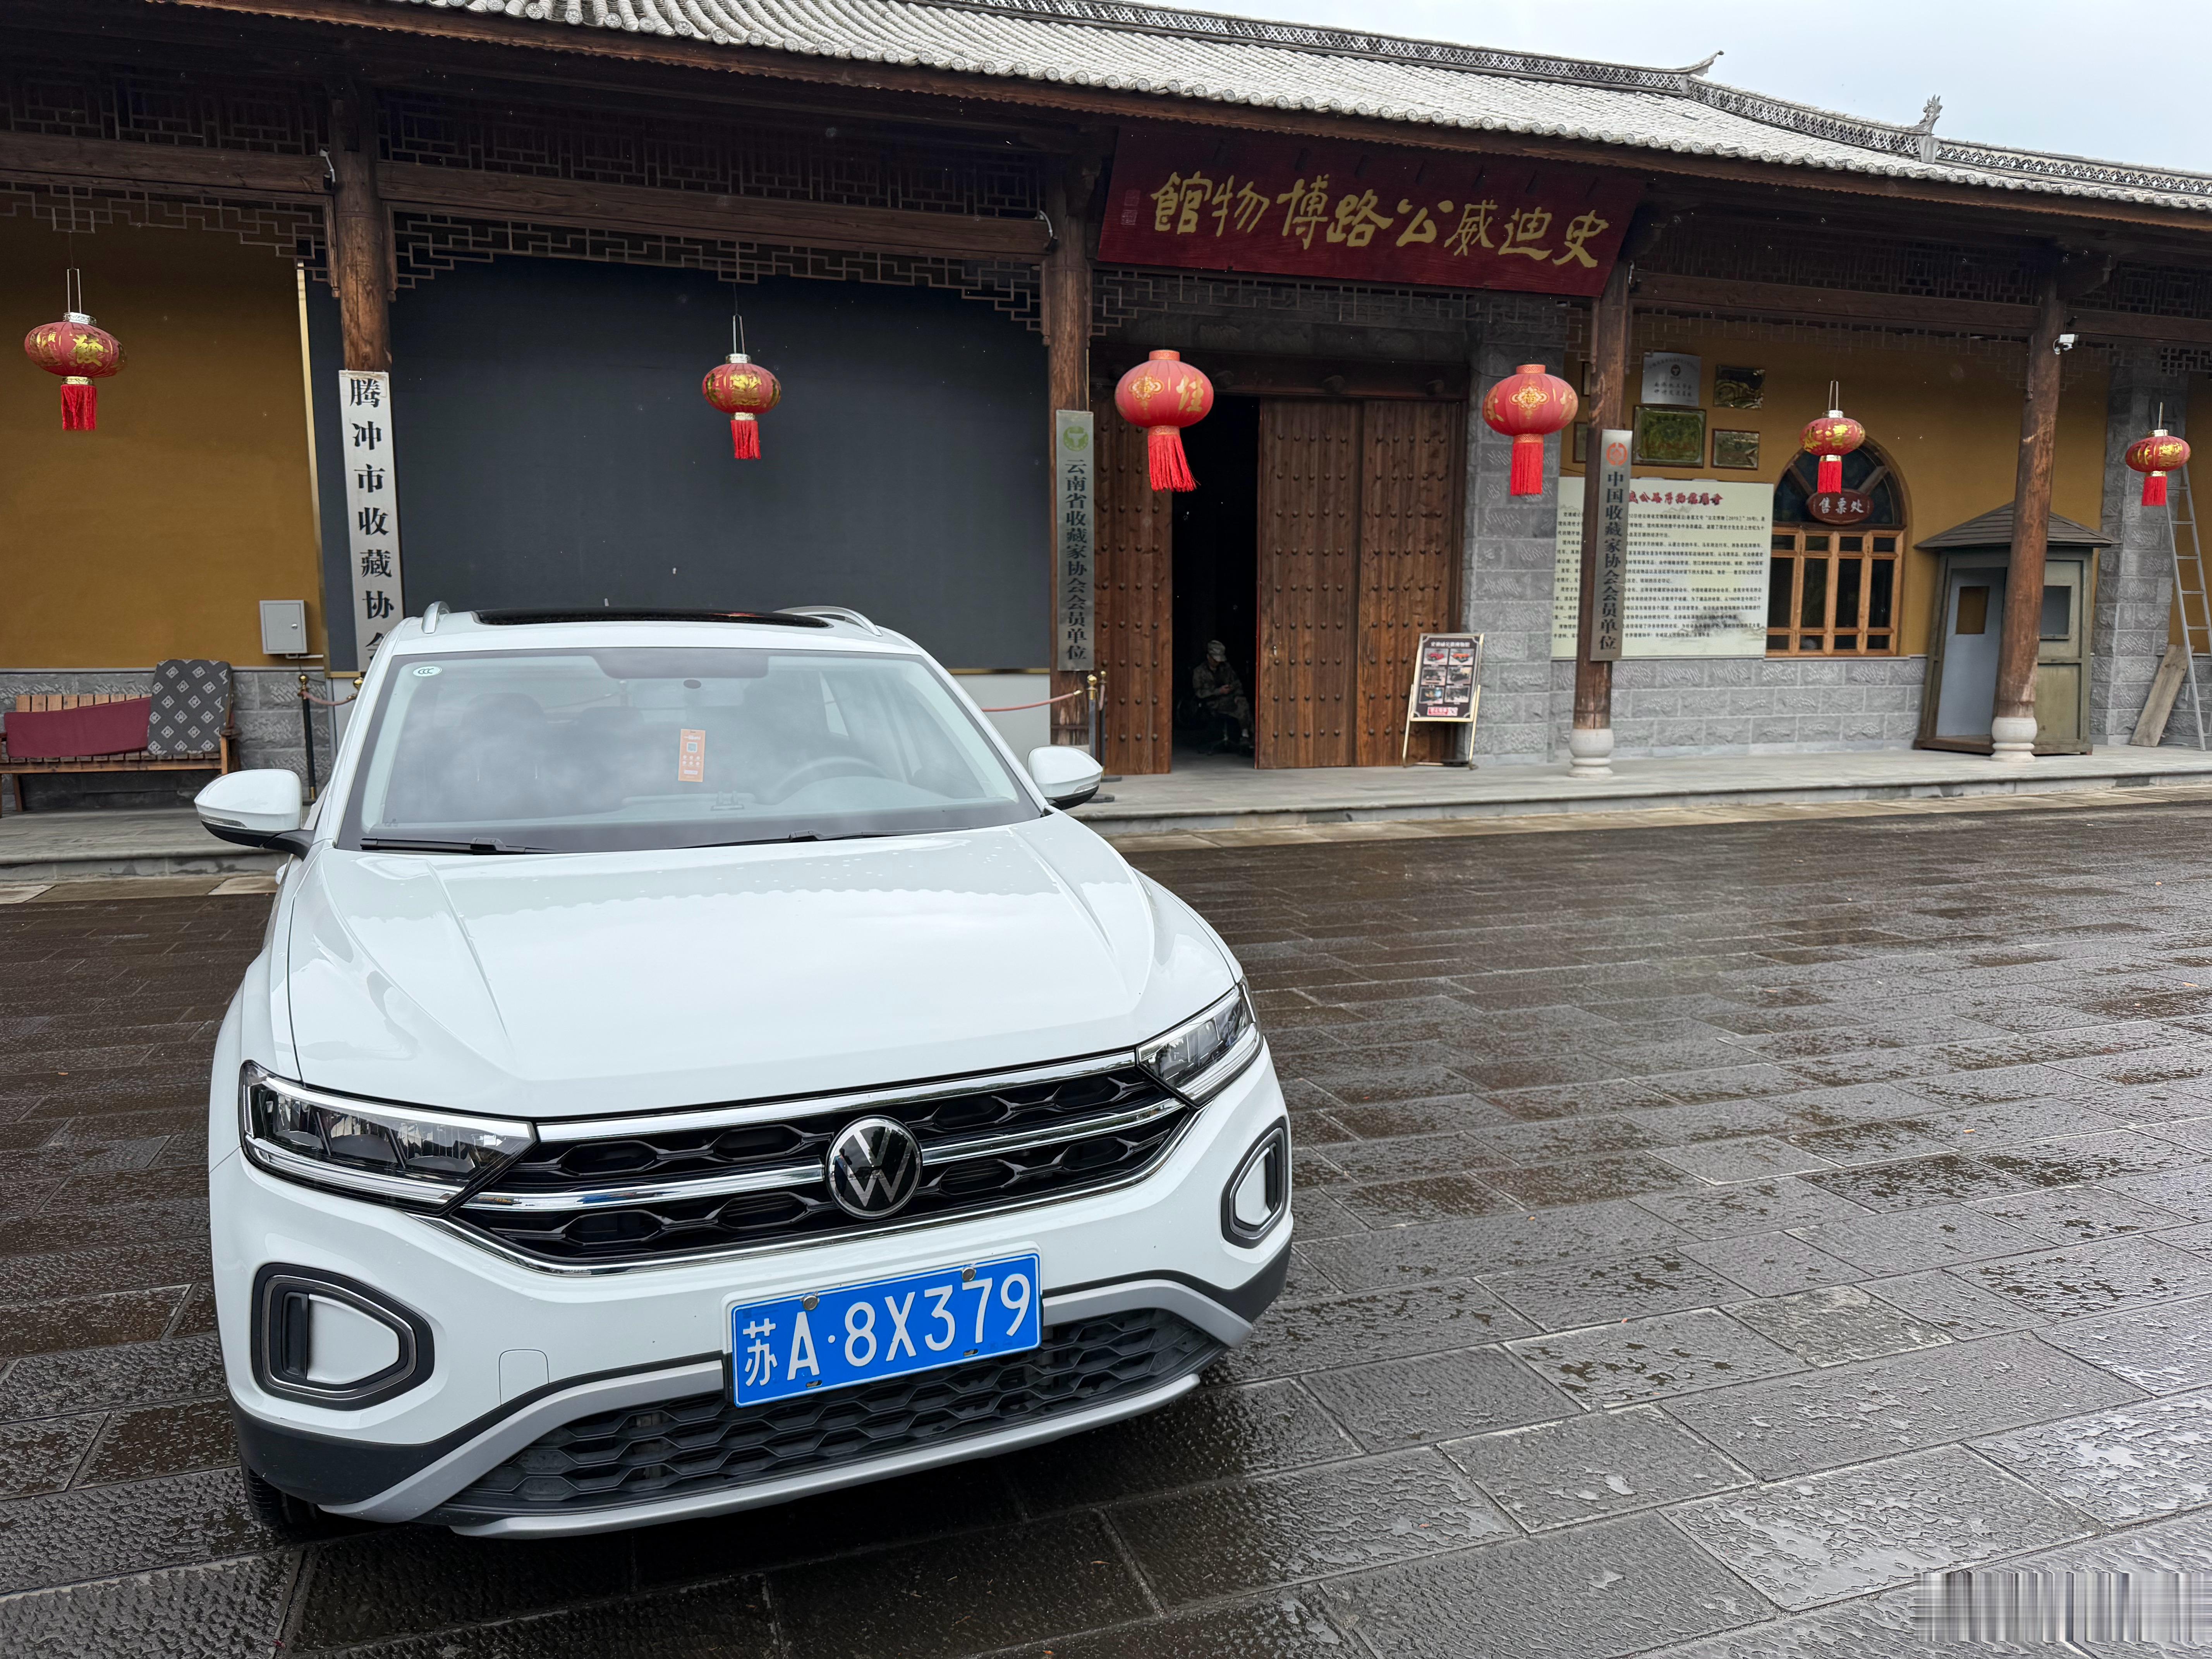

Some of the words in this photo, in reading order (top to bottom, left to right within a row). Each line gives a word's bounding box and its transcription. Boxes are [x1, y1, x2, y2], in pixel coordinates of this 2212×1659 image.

[1065, 459, 1087, 660] 云南省收藏家协会会员单位
[1599, 471, 1623, 651] 中国收藏家协会会员单位
[1818, 497, 1864, 514] 售票处
